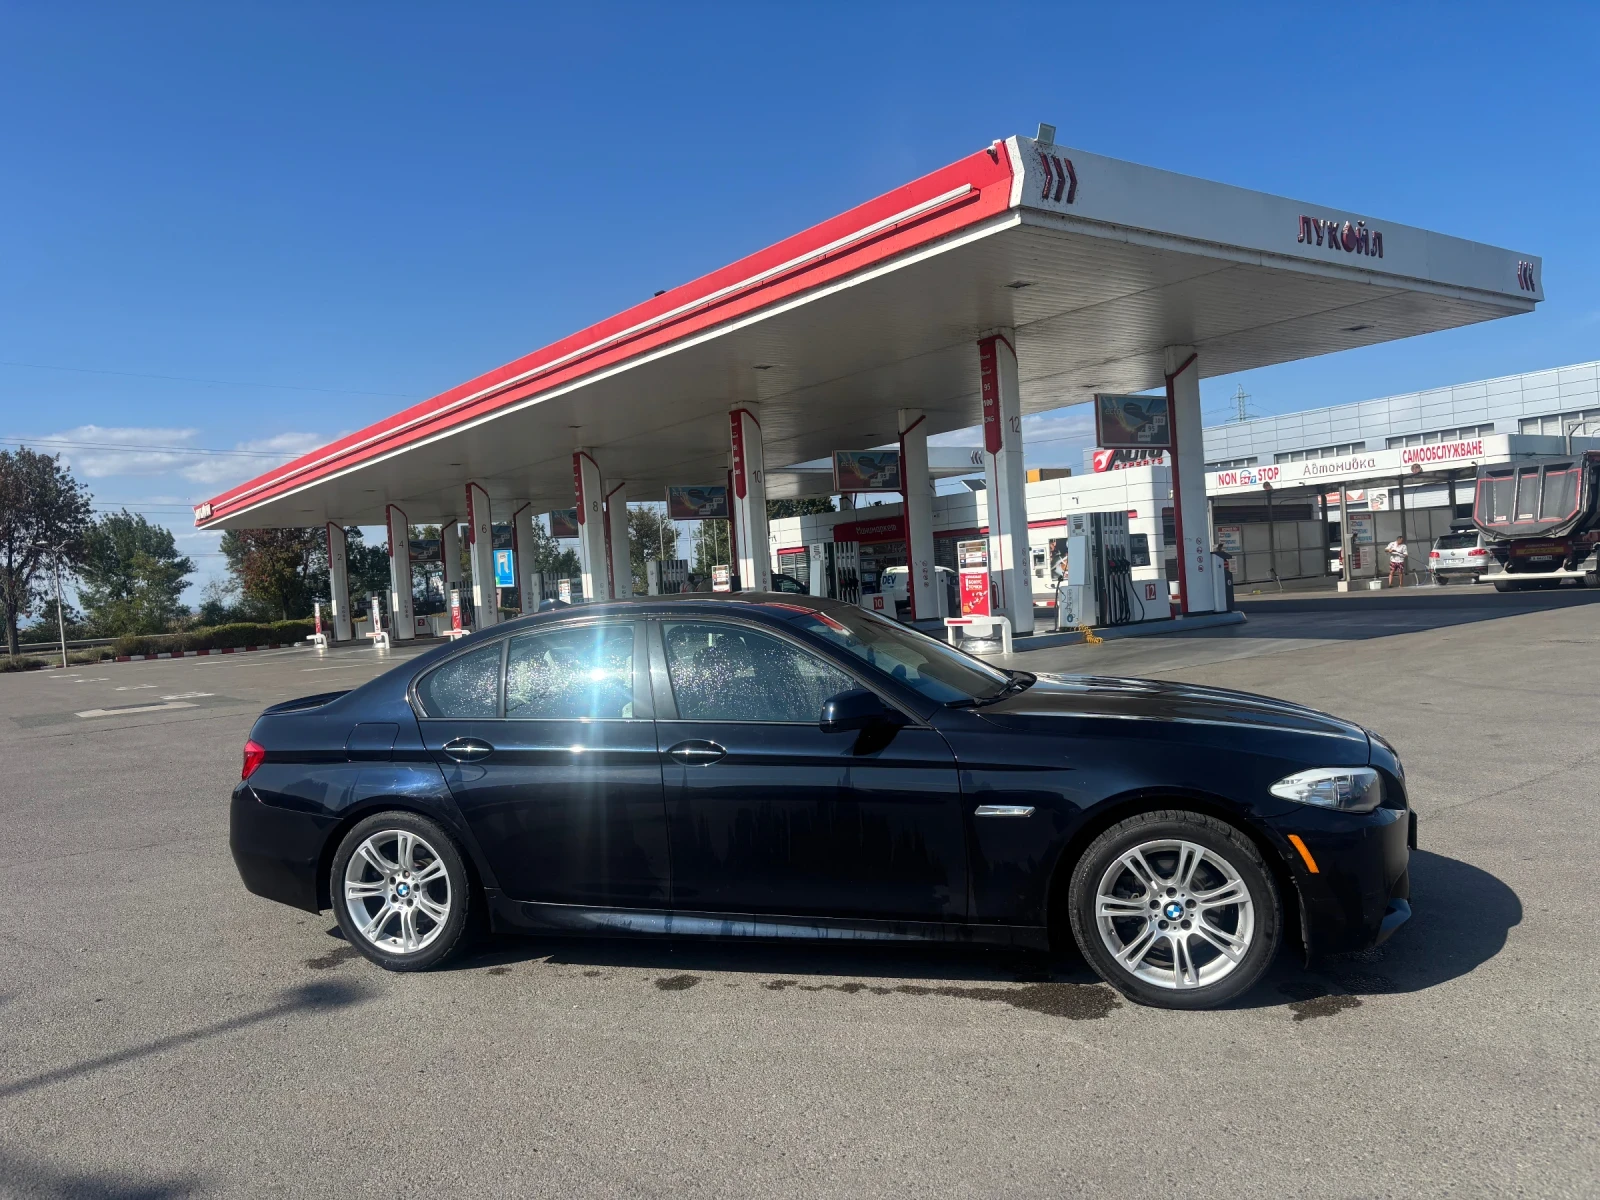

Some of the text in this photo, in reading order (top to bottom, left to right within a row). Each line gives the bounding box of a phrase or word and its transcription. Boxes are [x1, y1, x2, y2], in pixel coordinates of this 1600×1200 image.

[1009, 415, 1020, 433] 12
[1402, 440, 1483, 464] САМООБСЛУЖВАНЕ
[1113, 457, 1164, 470] EXPERTS
[752, 470, 762, 484] 10
[1218, 472, 1237, 486] NON
[1258, 467, 1279, 481] STOP
[592, 500, 599, 512] 8
[481, 524, 487, 534] 6
[398, 540, 404, 548] 4
[1145, 585, 1155, 599] 12
[874, 599, 883, 608] 10
